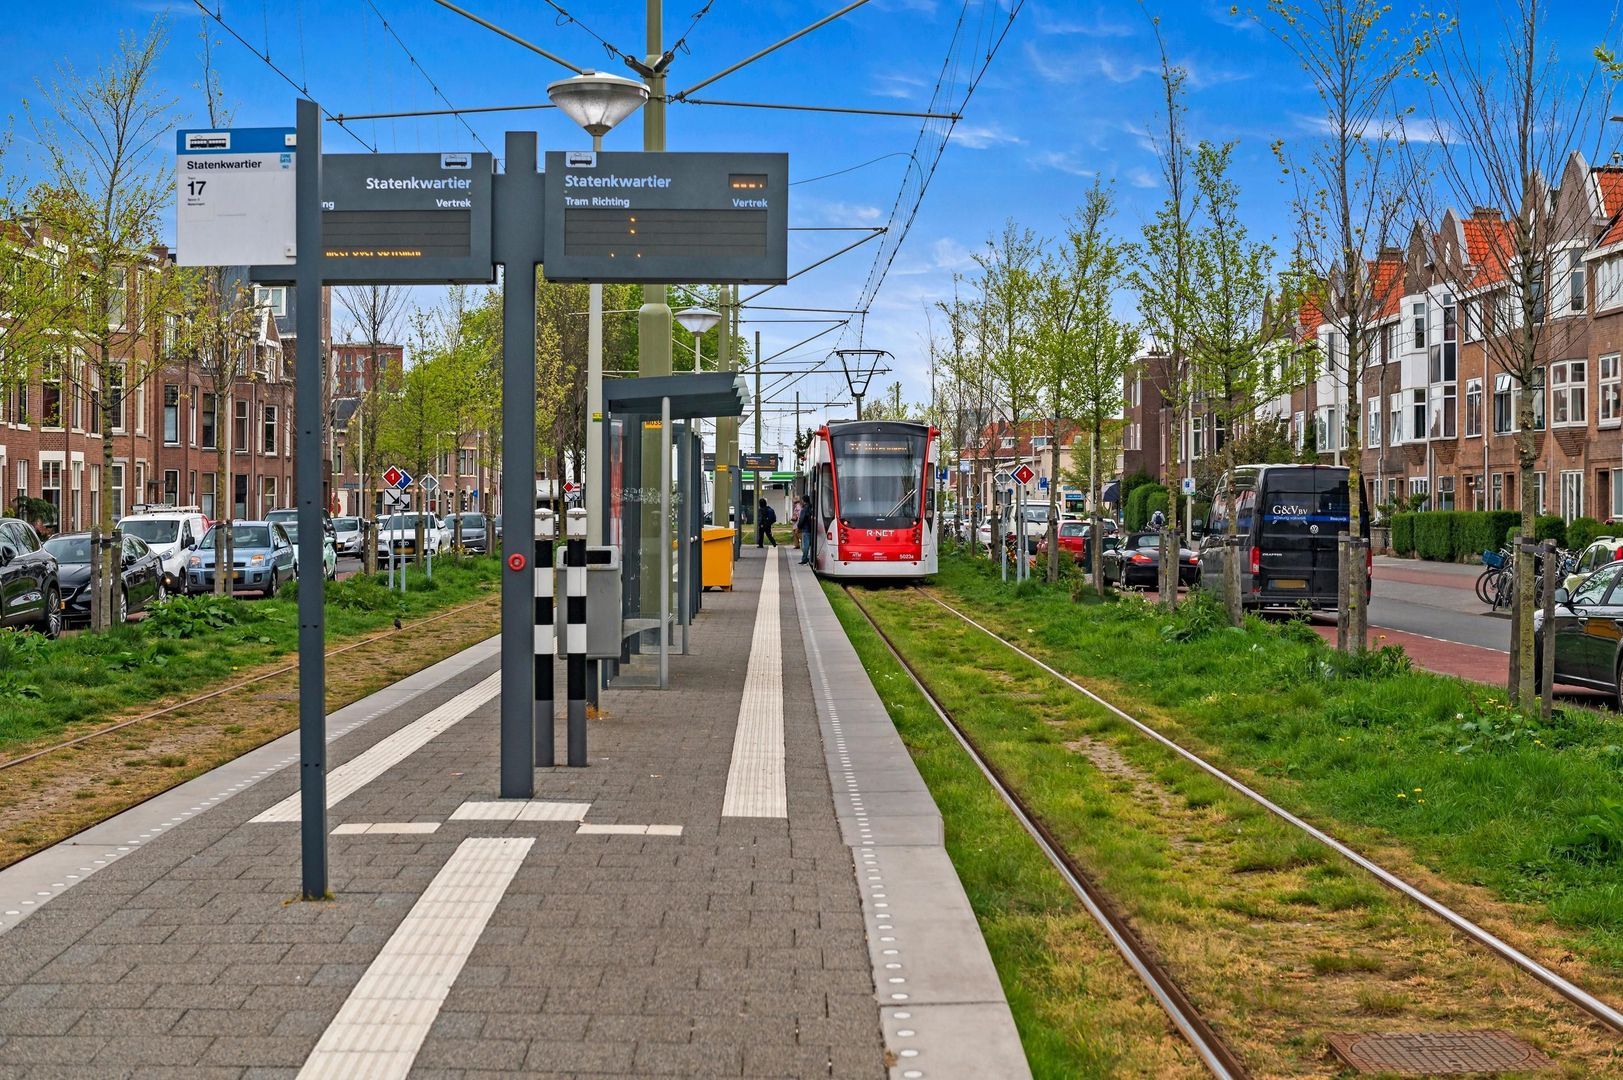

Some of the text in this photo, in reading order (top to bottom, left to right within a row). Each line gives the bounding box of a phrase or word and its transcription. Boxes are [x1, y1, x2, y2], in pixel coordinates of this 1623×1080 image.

[187, 160, 261, 169] Statenkwartier
[366, 176, 472, 189] Statenkwartier
[564, 174, 671, 188] Statenkwartier
[187, 181, 206, 196] 17
[435, 199, 472, 208] Vertrek
[565, 197, 630, 208] Tram Richting
[732, 198, 768, 208] Vertrek
[1022, 471, 1027, 479] 1
